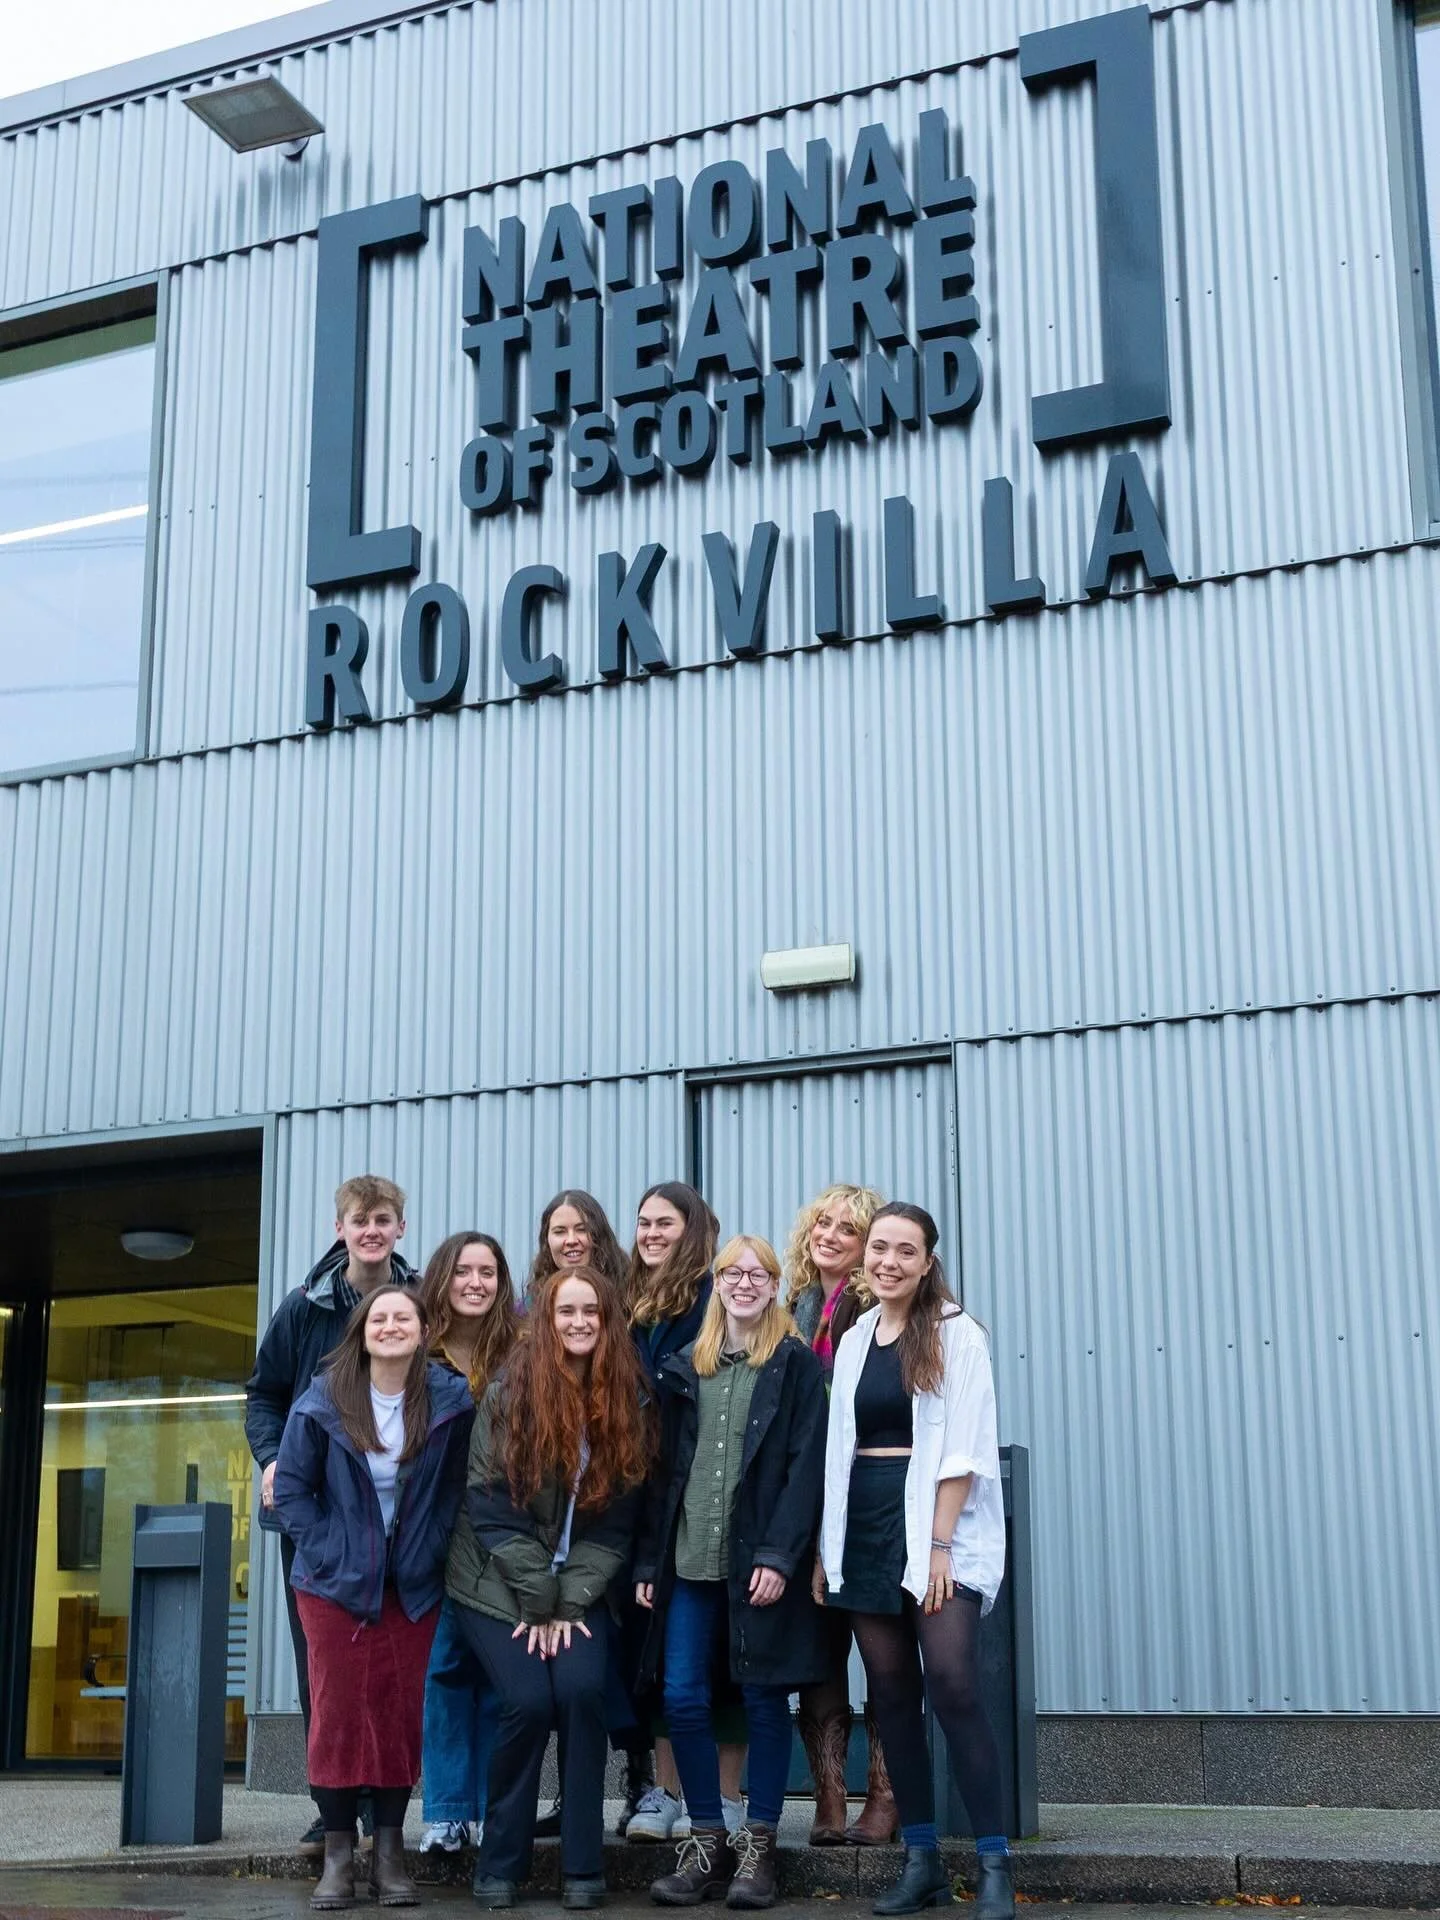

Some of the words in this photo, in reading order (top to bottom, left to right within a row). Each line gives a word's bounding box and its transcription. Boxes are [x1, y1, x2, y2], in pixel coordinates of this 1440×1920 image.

[462, 208, 980, 433] THEATRE
[464, 107, 976, 324] NATIONAL
[460, 425, 553, 515] OF
[570, 336, 982, 495] SCOTLAND
[306, 451, 1177, 729] ROCKVILLA
